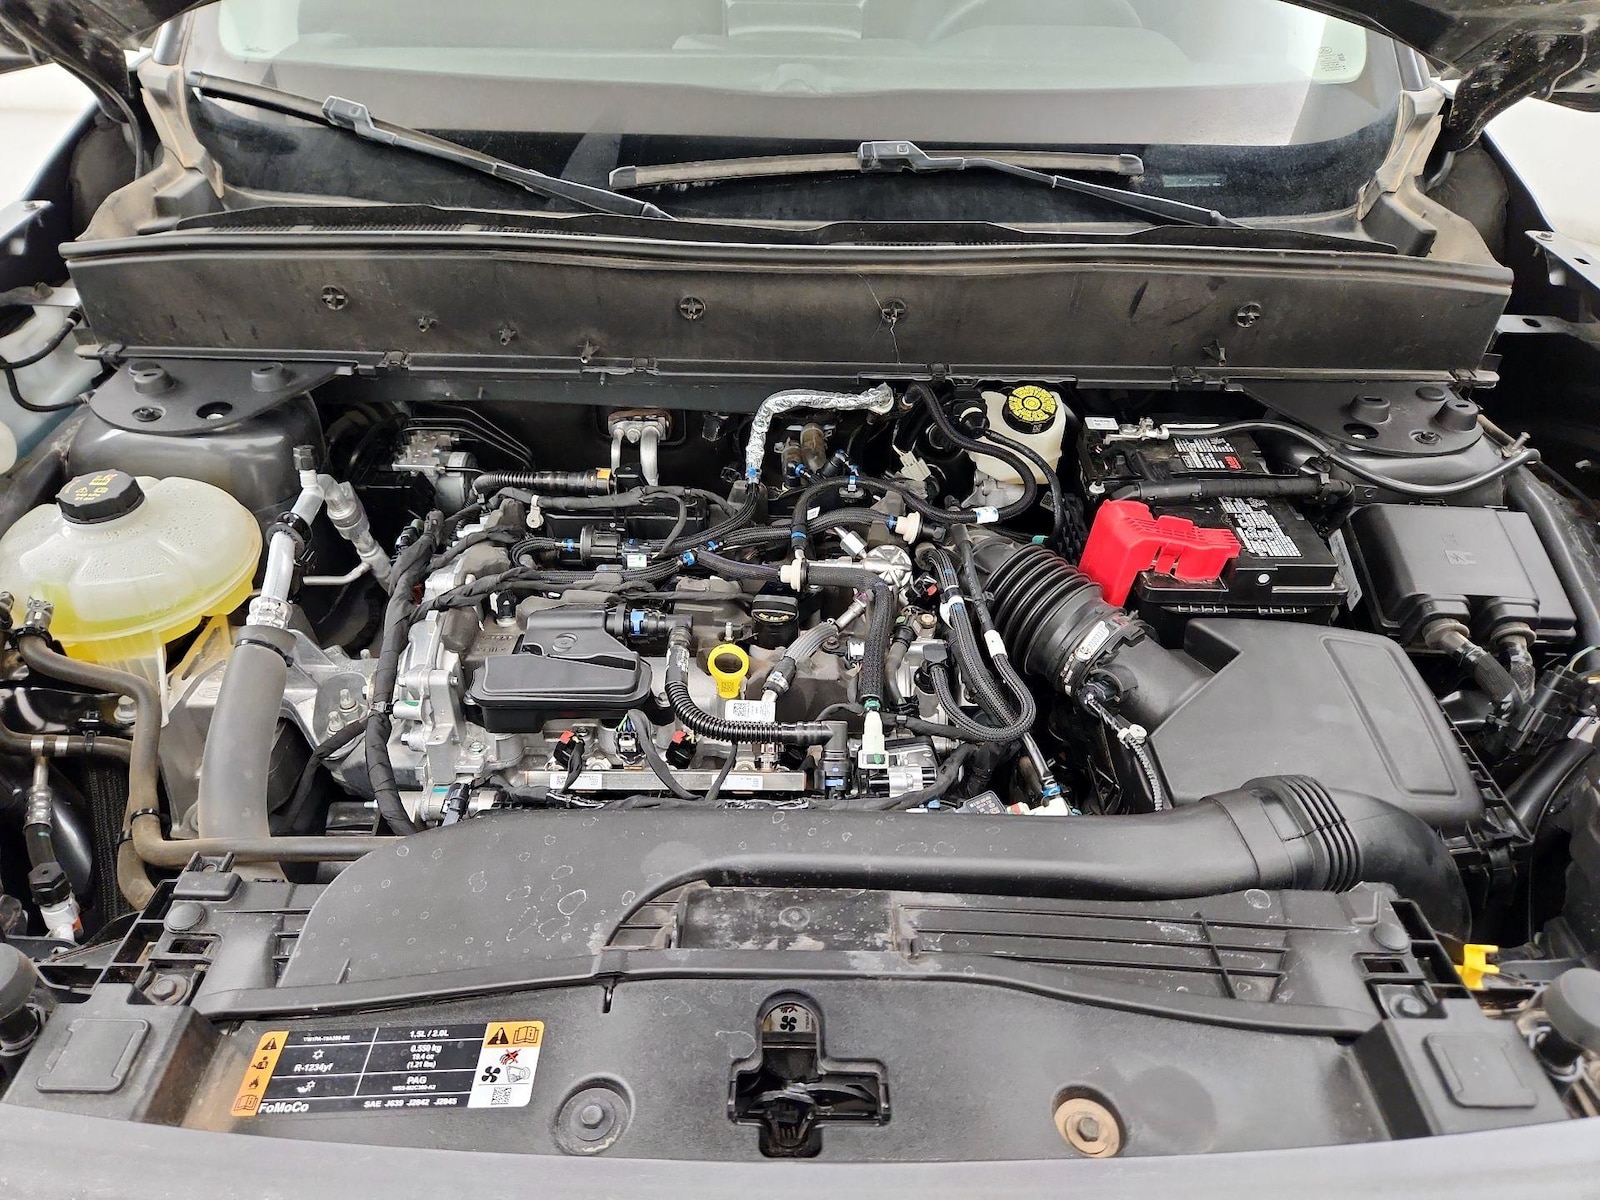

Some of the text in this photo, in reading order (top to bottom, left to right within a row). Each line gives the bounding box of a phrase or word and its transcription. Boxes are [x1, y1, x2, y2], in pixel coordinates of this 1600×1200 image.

[409, 1030, 426, 1039] 1.5L
[432, 1029, 450, 1038] 2.0L
[431, 1043, 443, 1054] kg
[293, 1062, 333, 1073] R-1234yf
[406, 1076, 428, 1085] PAG
[258, 1101, 310, 1114] FoMoCo
[363, 1099, 382, 1109] SAE
